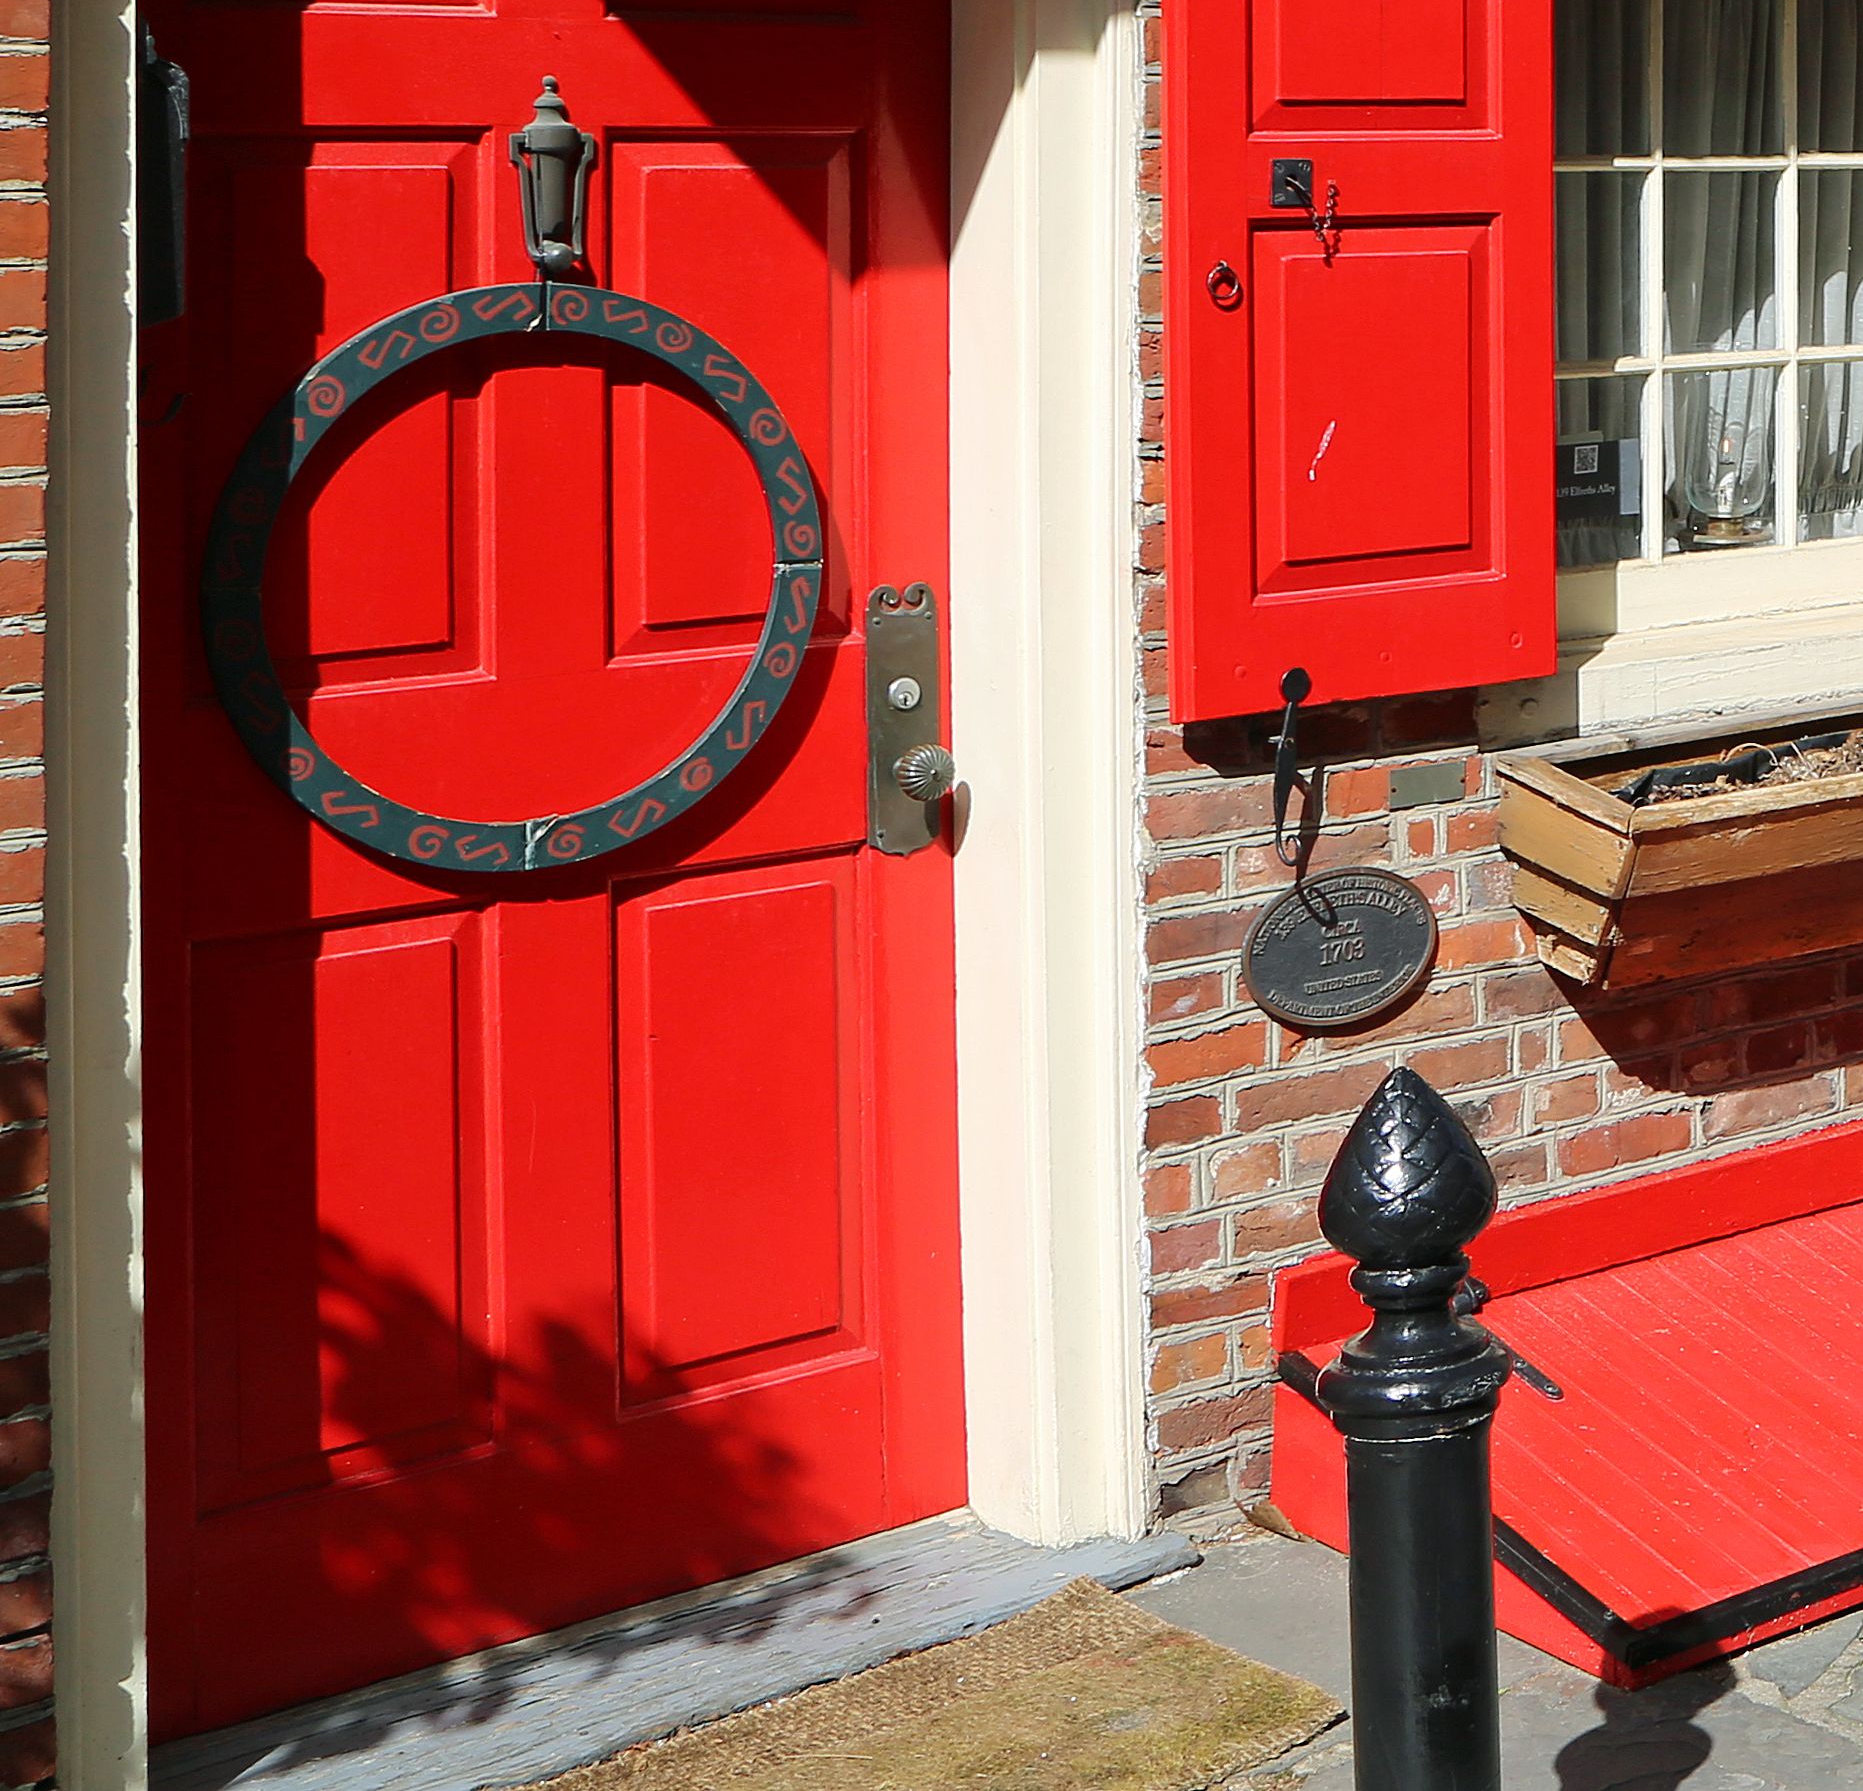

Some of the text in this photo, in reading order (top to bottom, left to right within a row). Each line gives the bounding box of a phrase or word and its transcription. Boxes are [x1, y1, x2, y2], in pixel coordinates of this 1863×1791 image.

[1365, 890, 1407, 917] ALLEY
[1321, 918, 1361, 939] CIRCA
[1319, 936, 1366, 966] 1703
[1303, 969, 1384, 995] UNITED STATES
[1266, 989, 1332, 1017] DEPARTMENT
